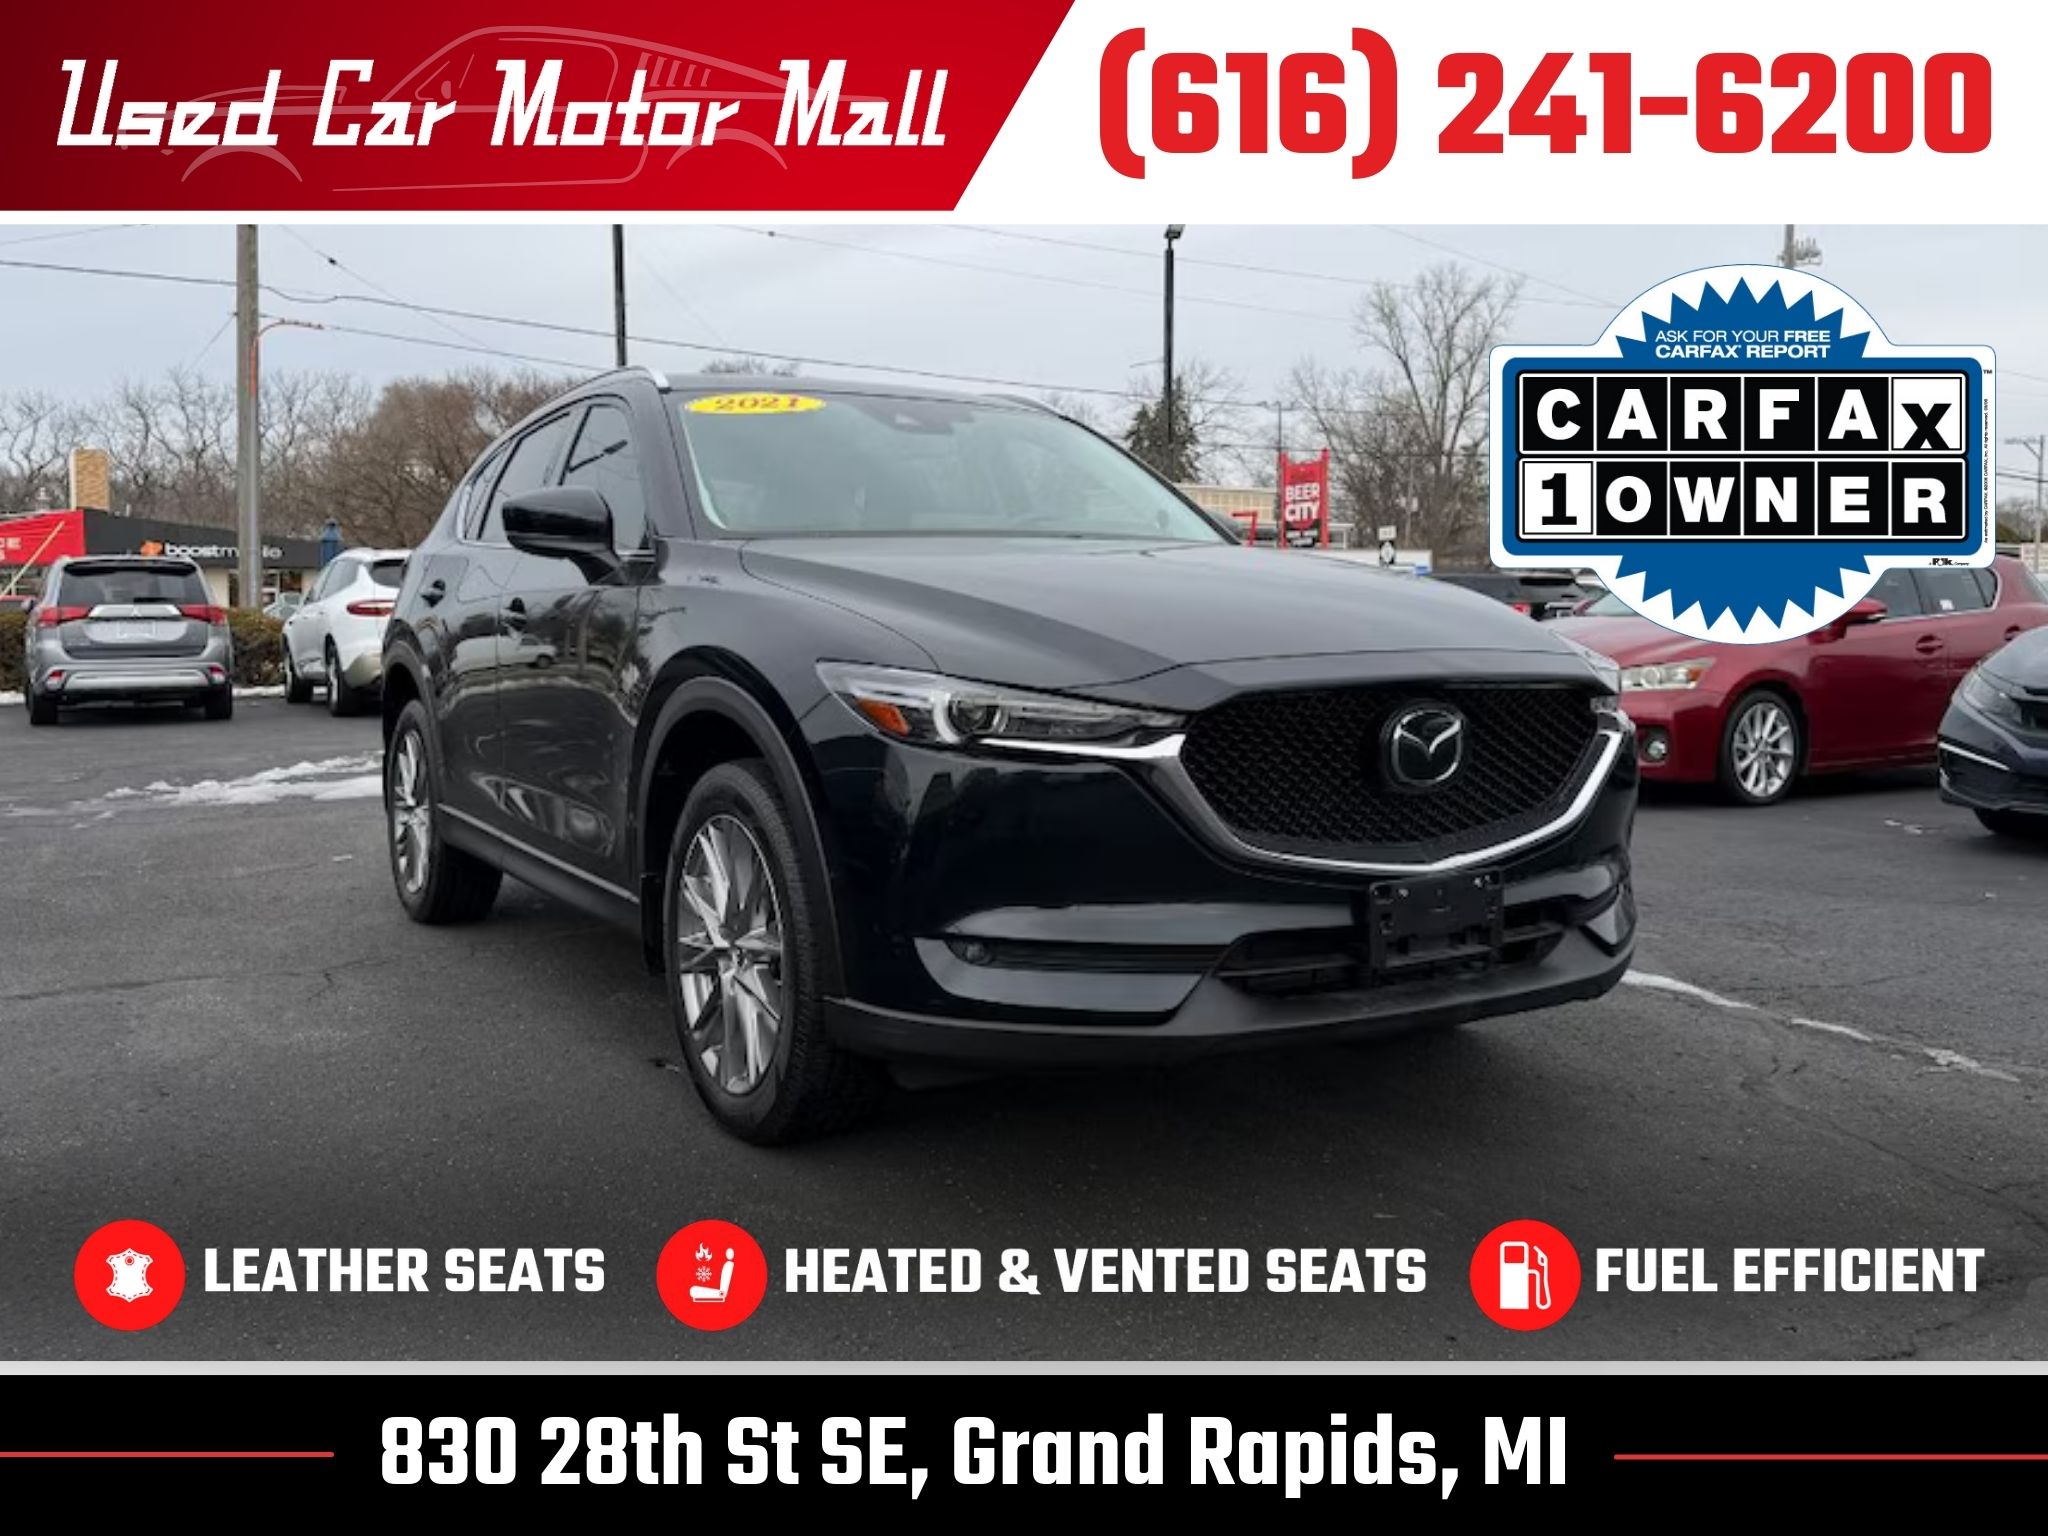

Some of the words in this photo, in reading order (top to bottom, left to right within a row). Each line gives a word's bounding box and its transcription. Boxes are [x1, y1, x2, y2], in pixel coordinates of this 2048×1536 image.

[713, 396, 801, 411] 2021
[1285, 482, 1320, 502] BEER
[1285, 501, 1320, 522] CITY
